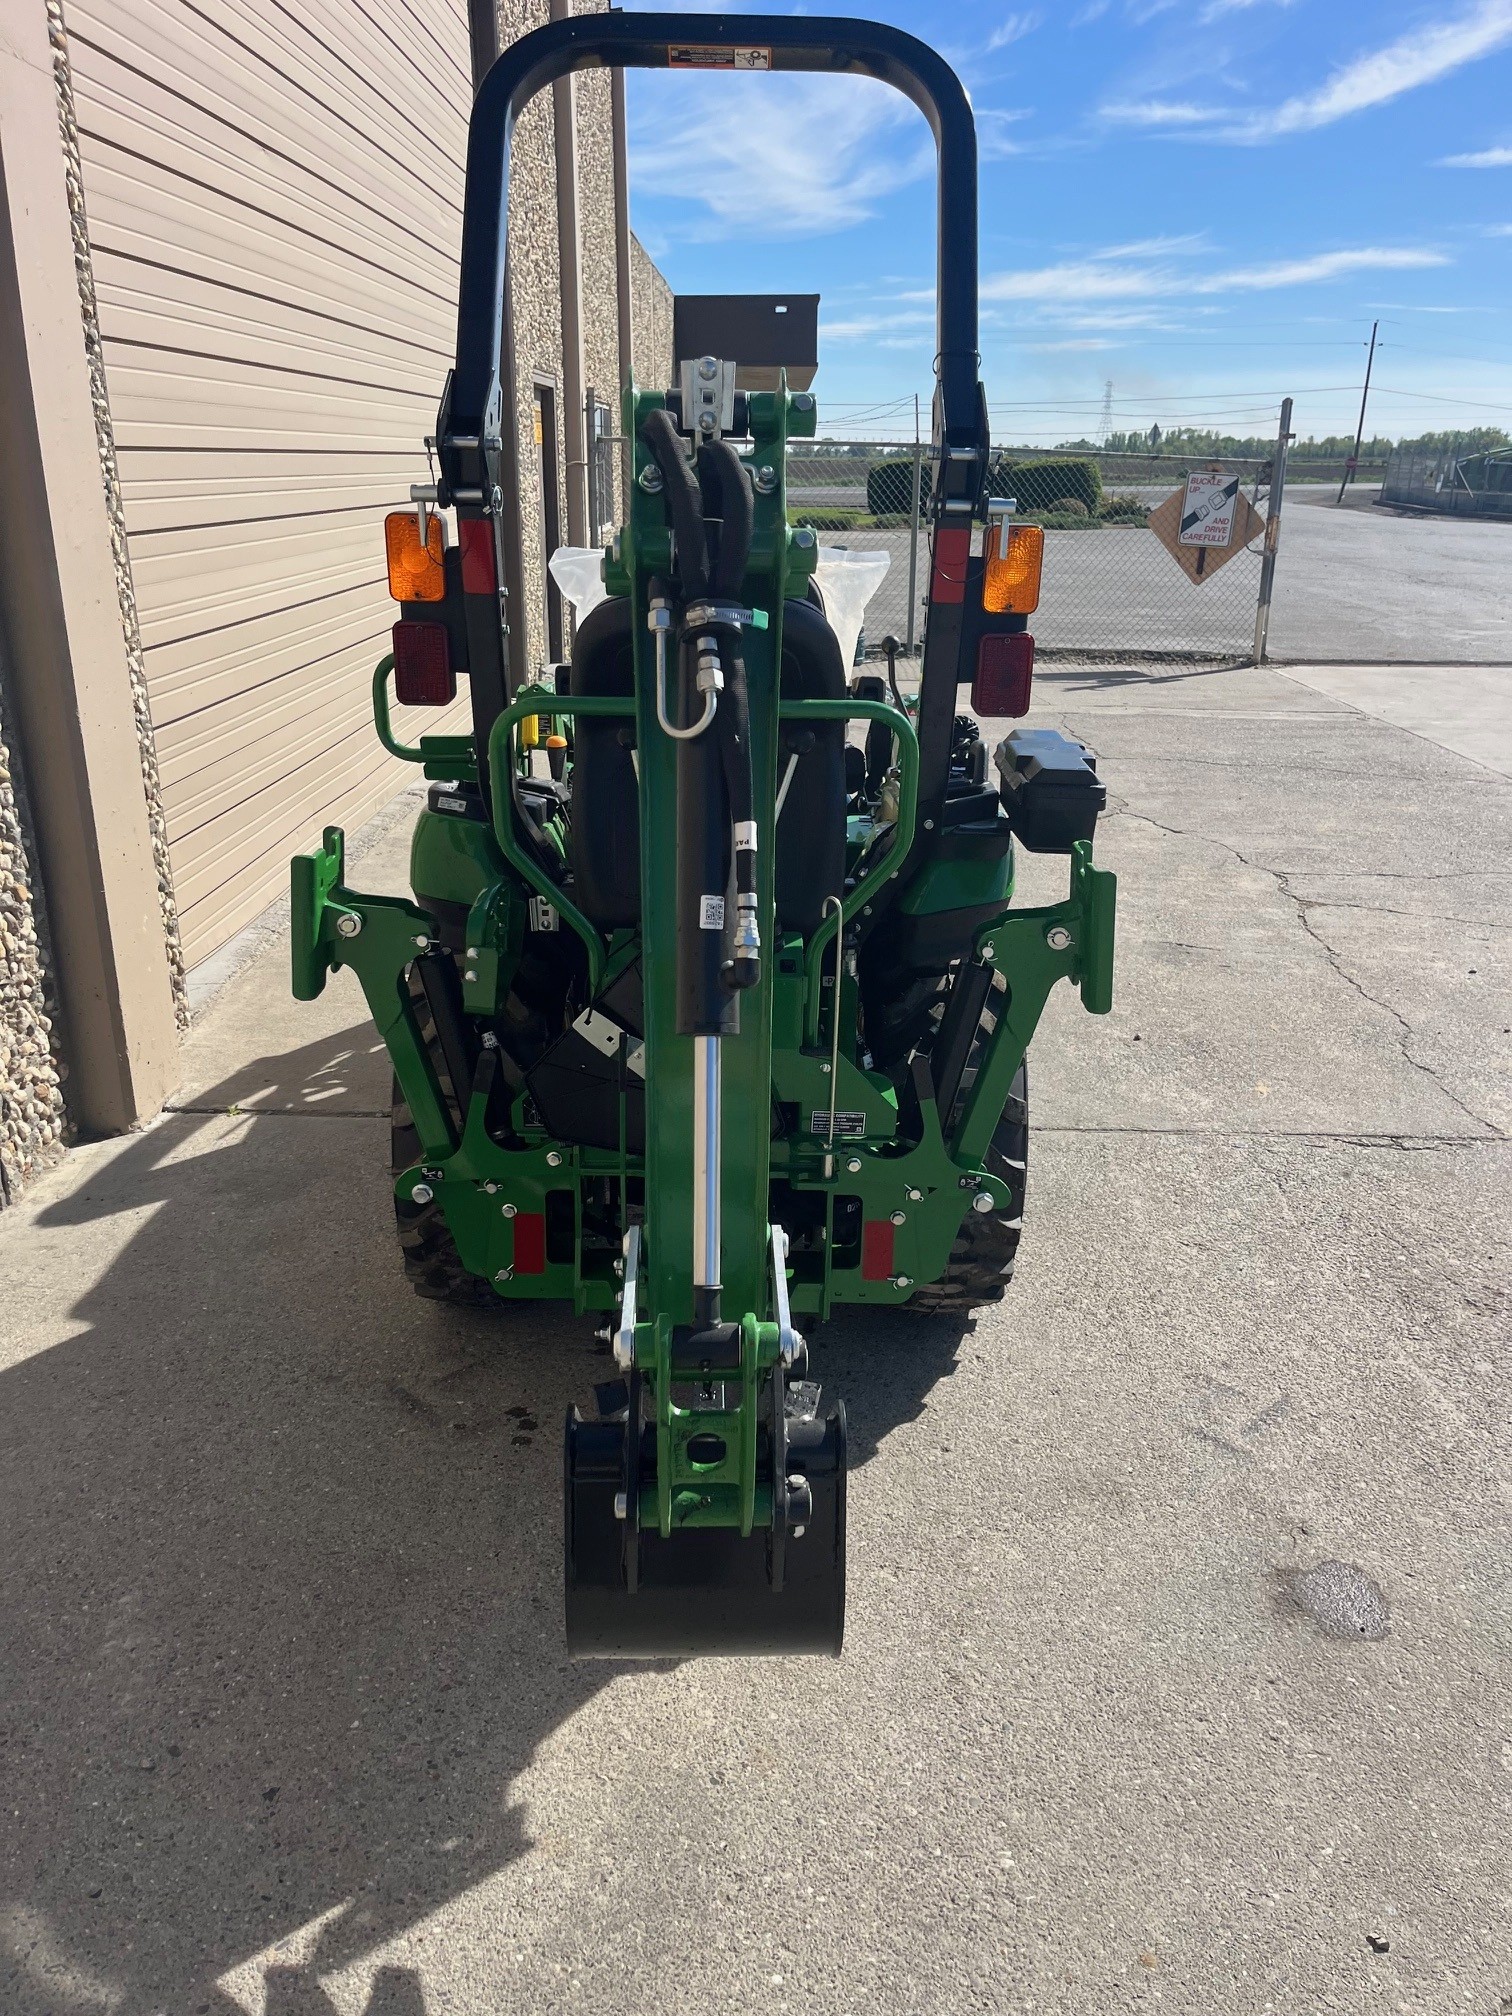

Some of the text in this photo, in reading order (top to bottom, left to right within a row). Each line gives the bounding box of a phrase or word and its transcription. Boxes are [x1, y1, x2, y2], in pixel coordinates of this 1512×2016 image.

[1190, 478, 1222, 486] BUCKLE
[1204, 525, 1228, 534] DRIVE
[1182, 532, 1227, 542] CAREFULLY
